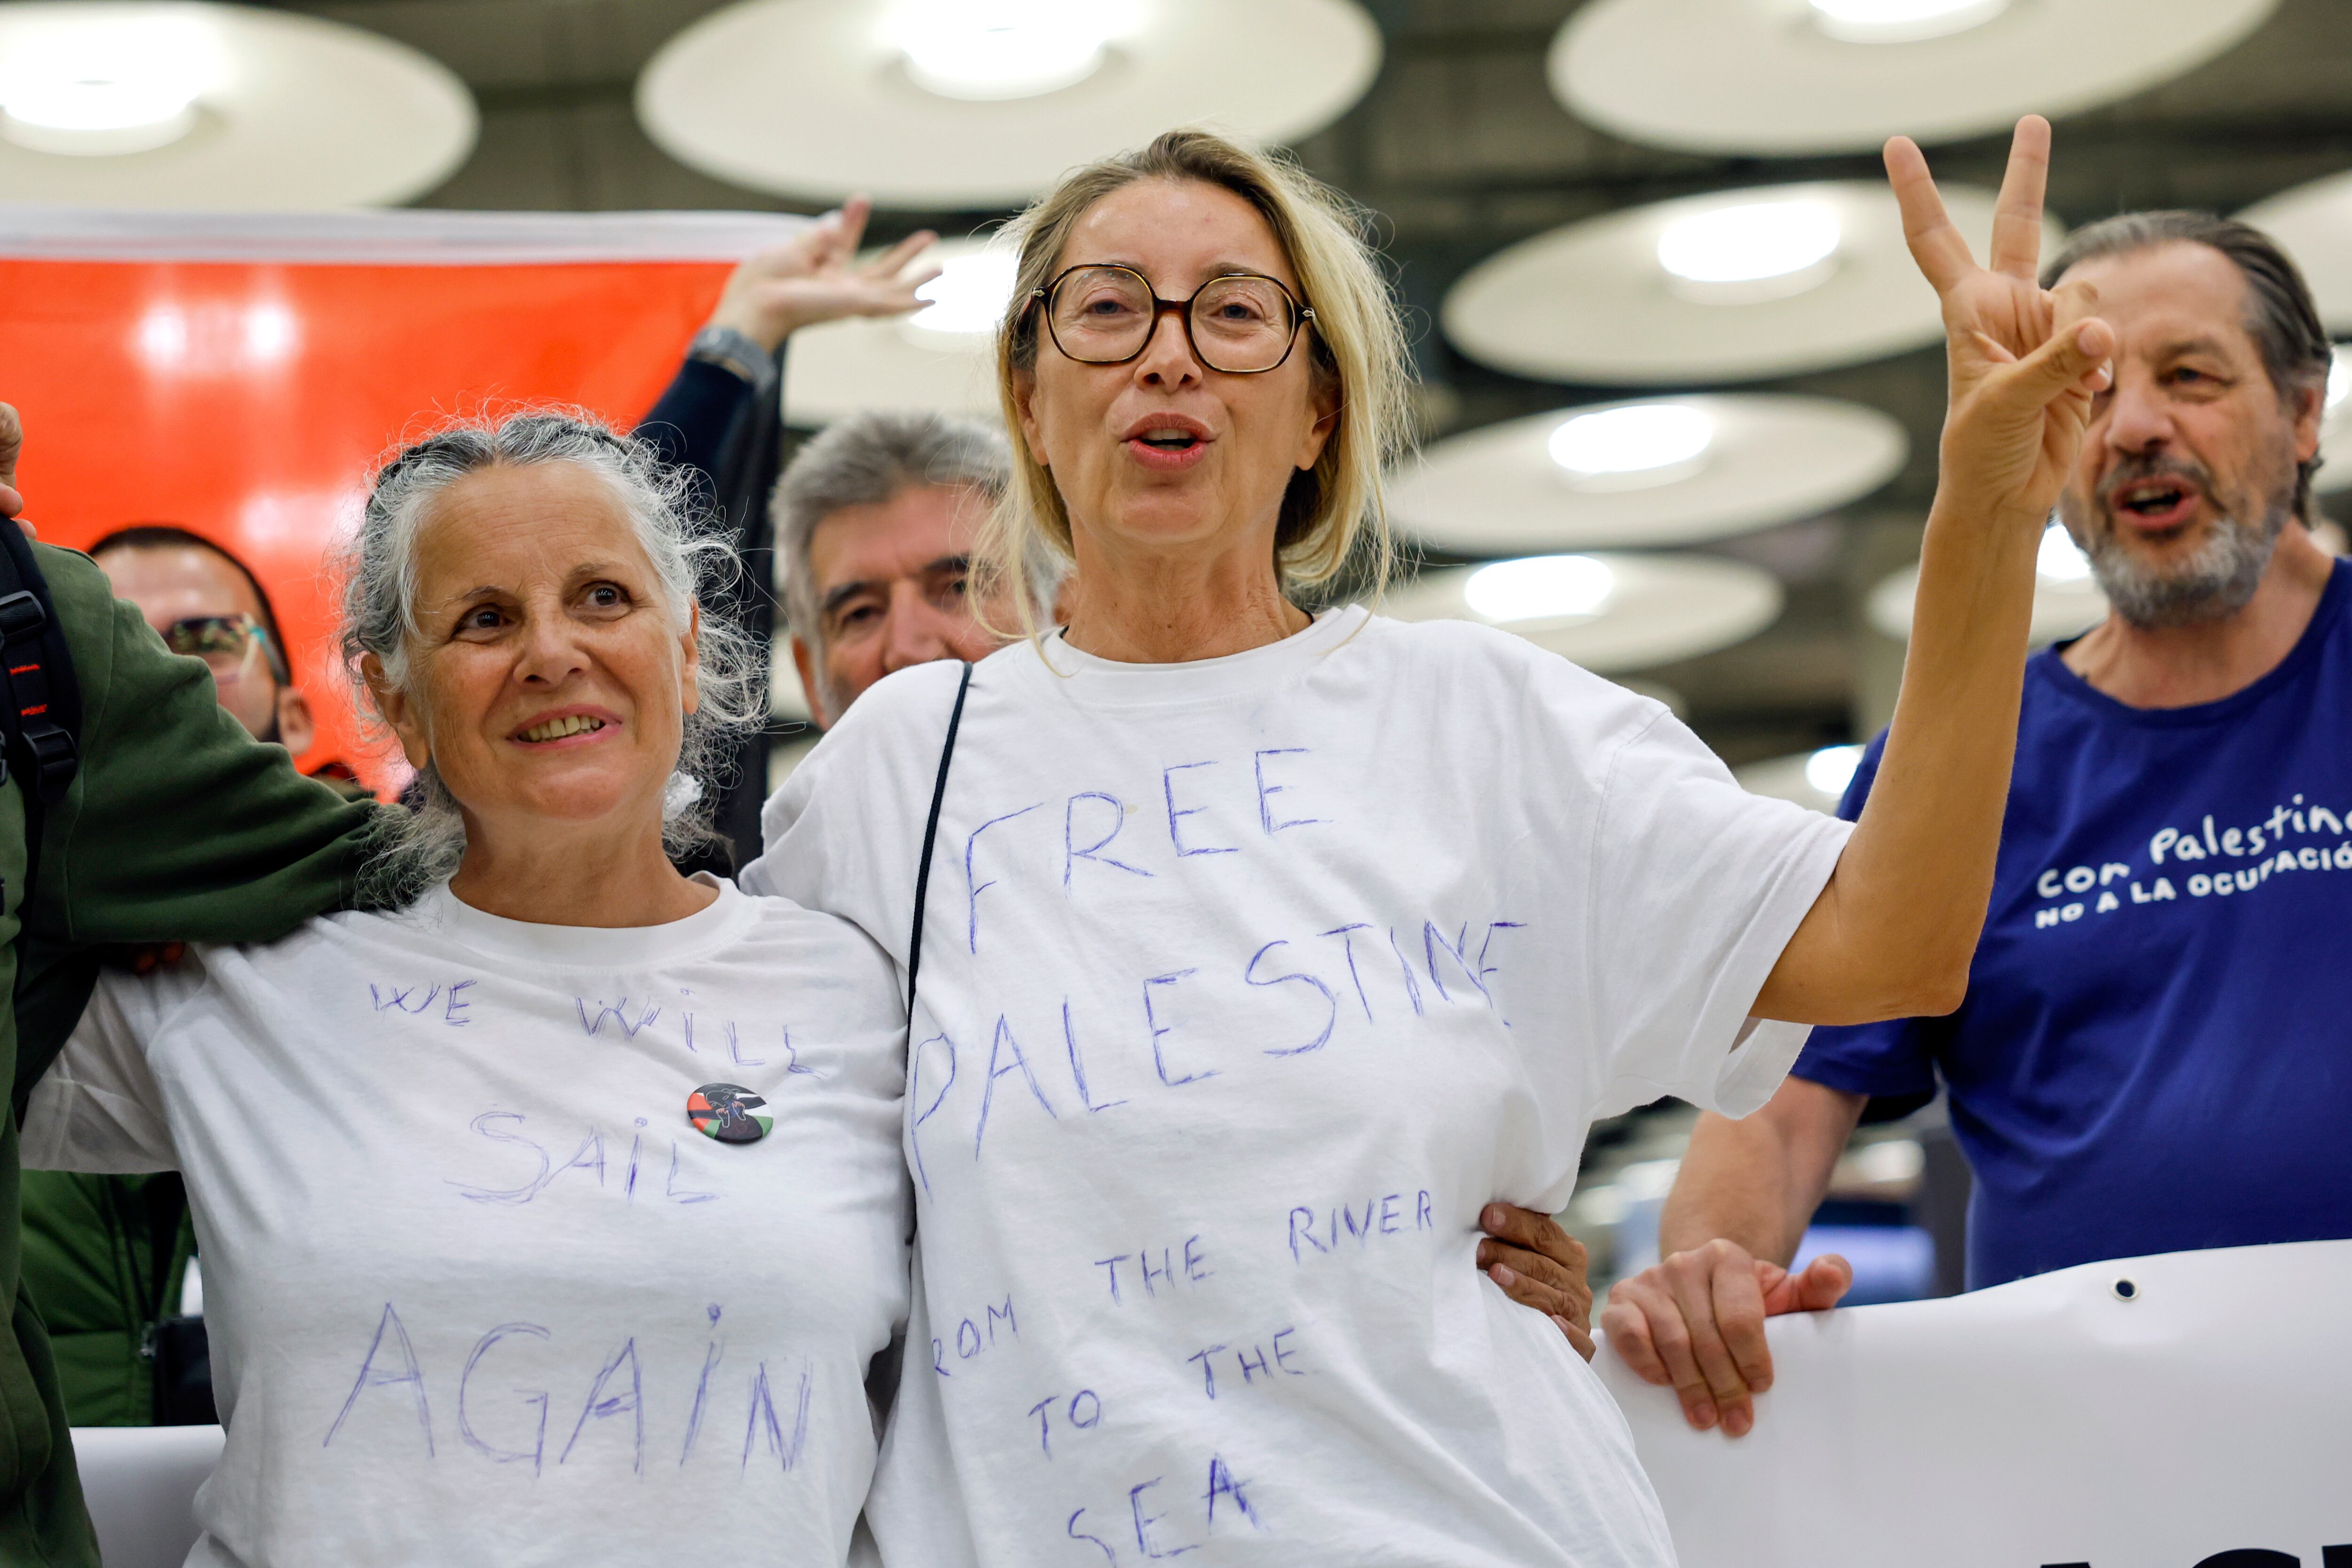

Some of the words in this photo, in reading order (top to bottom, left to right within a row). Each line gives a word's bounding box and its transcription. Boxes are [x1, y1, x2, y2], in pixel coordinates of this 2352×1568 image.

[965, 748, 1334, 956] FREE
[2034, 902, 2085, 930] NO
[2096, 891, 2120, 914] A
[2129, 876, 2177, 904] LA
[2186, 840, 2352, 897] OCUPACIÓ
[370, 980, 477, 1027] WE
[912, 919, 1528, 1204] PALESTINE
[931, 1292, 1020, 1377] ROM
[1094, 1234, 1214, 1306] THE
[1288, 1190, 1432, 1266] RIVER
[1028, 1389, 1101, 1460] TO
[1187, 1327, 1305, 1400] THE
[1068, 1453, 1270, 1568] SEA
